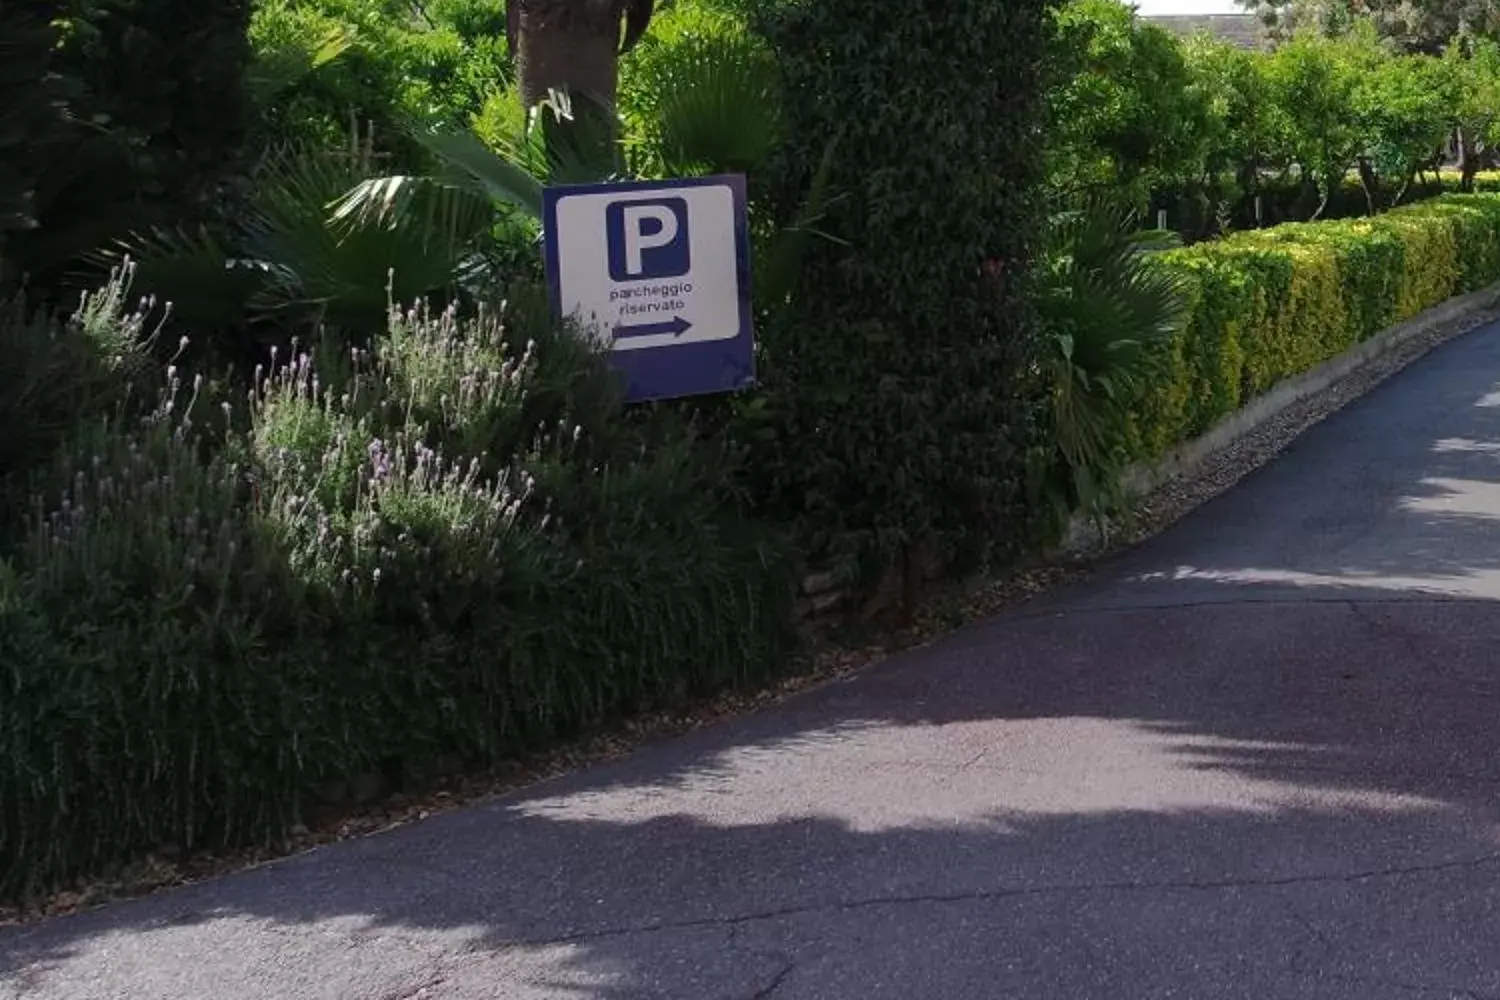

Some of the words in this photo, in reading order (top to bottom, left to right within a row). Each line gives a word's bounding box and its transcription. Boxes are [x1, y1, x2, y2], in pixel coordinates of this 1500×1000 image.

[623, 205, 678, 275] P
[609, 283, 693, 300] parcheggio
[619, 300, 685, 315] riservato
